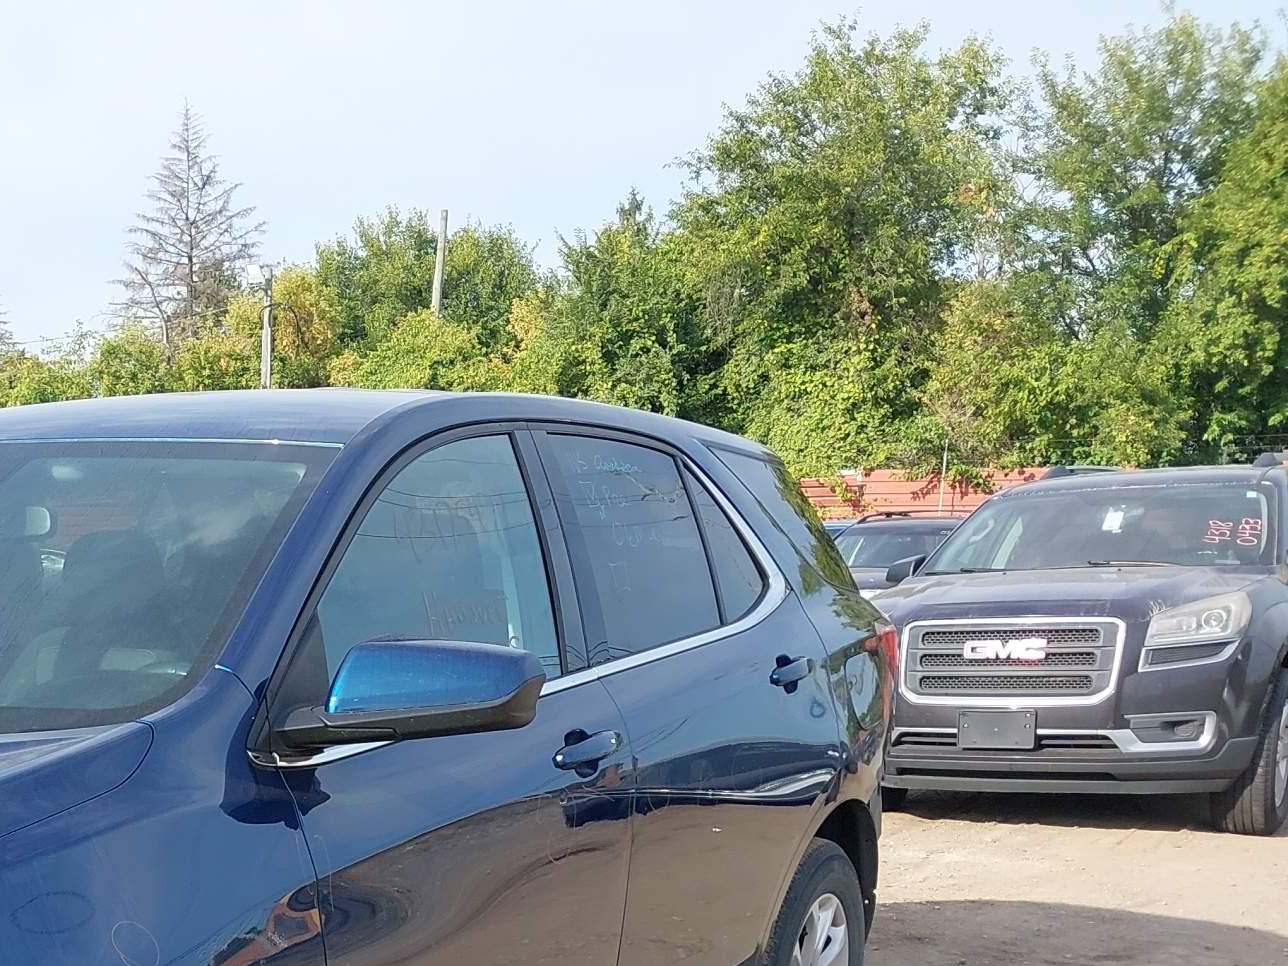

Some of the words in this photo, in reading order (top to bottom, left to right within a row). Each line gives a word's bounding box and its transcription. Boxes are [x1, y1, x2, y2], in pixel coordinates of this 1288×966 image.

[1201, 519, 1233, 544] 4318
[1237, 517, 1262, 545] 0433
[964, 638, 1047, 659] GMC
